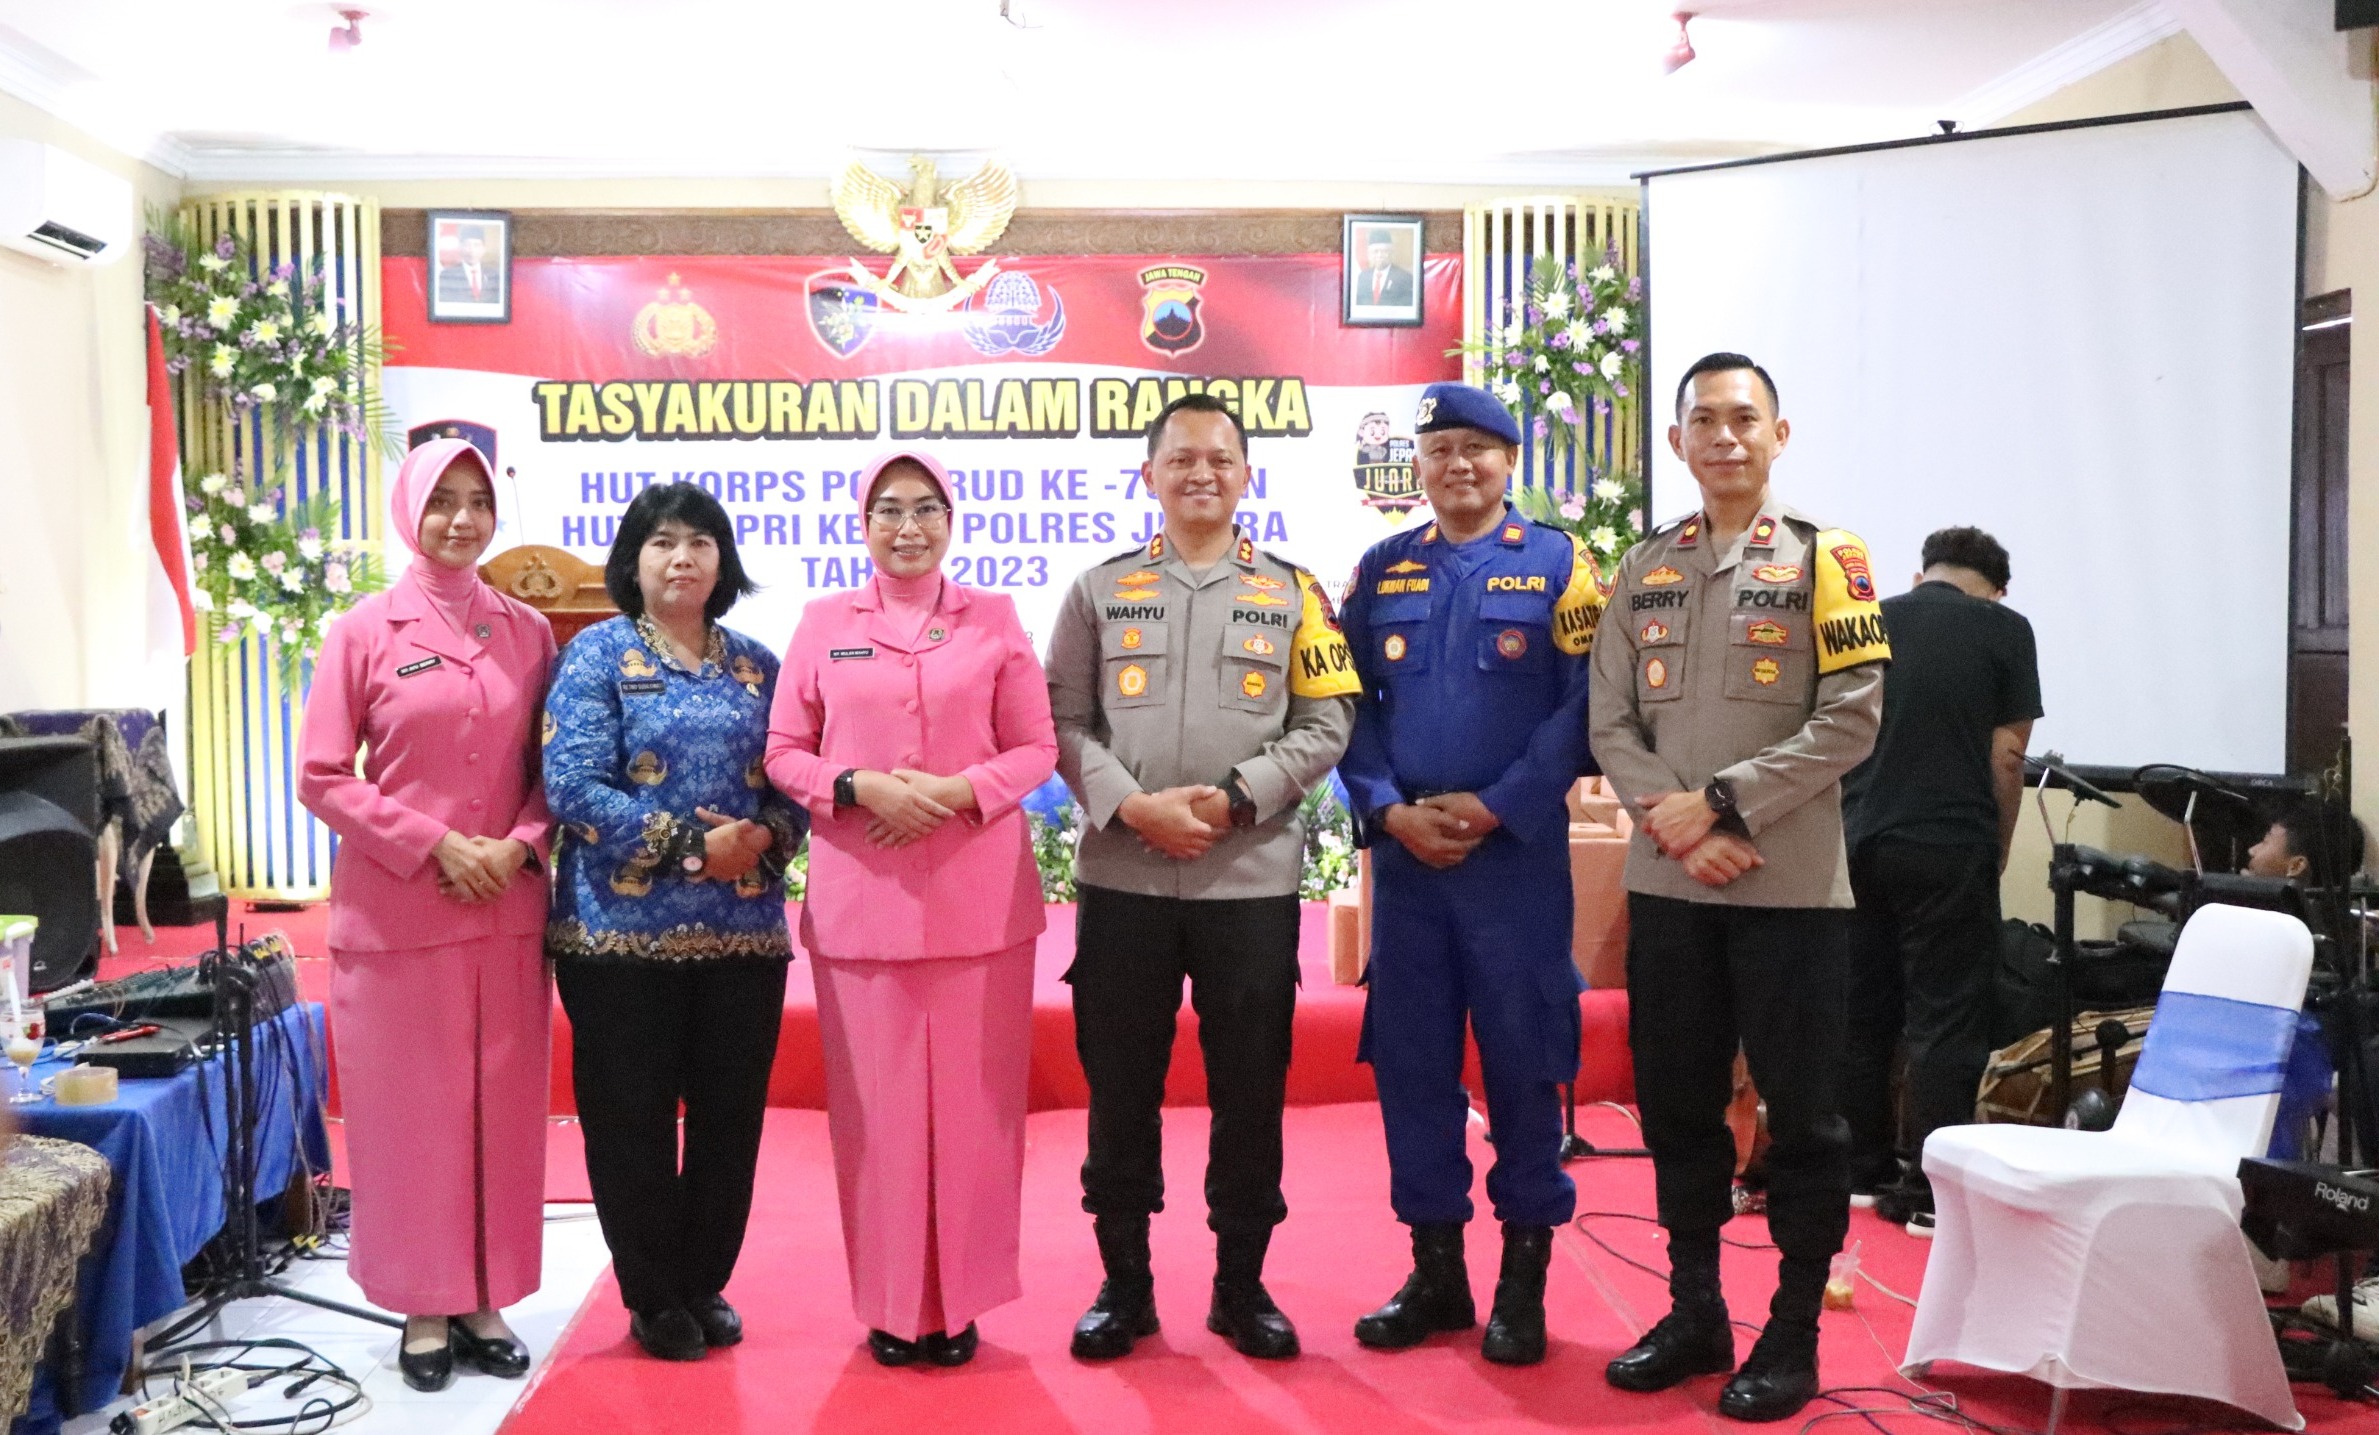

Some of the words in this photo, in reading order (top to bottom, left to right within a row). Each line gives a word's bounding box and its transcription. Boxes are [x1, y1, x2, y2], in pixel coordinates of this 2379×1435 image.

[1144, 268, 1168, 283] JAWA
[1167, 267, 1202, 283] TENGAH
[534, 380, 879, 438] TASYAKURAN
[893, 379, 1080, 436] DALAM
[1040, 469, 1088, 500] KE
[1363, 467, 1424, 493] JUAR
[562, 515, 626, 547] HU
[963, 512, 1116, 543] POLRES
[801, 556, 875, 588] TAH
[950, 556, 1049, 587] 2023
[1486, 576, 1546, 592] POLRI
[1106, 606, 1165, 621] WAHYU
[1631, 590, 1690, 611] BERRY
[1736, 589, 1809, 612] POLRI
[1232, 609, 1289, 629] POLRI
[1300, 644, 1329, 680] KA
[2314, 1181, 2370, 1211] Roland
